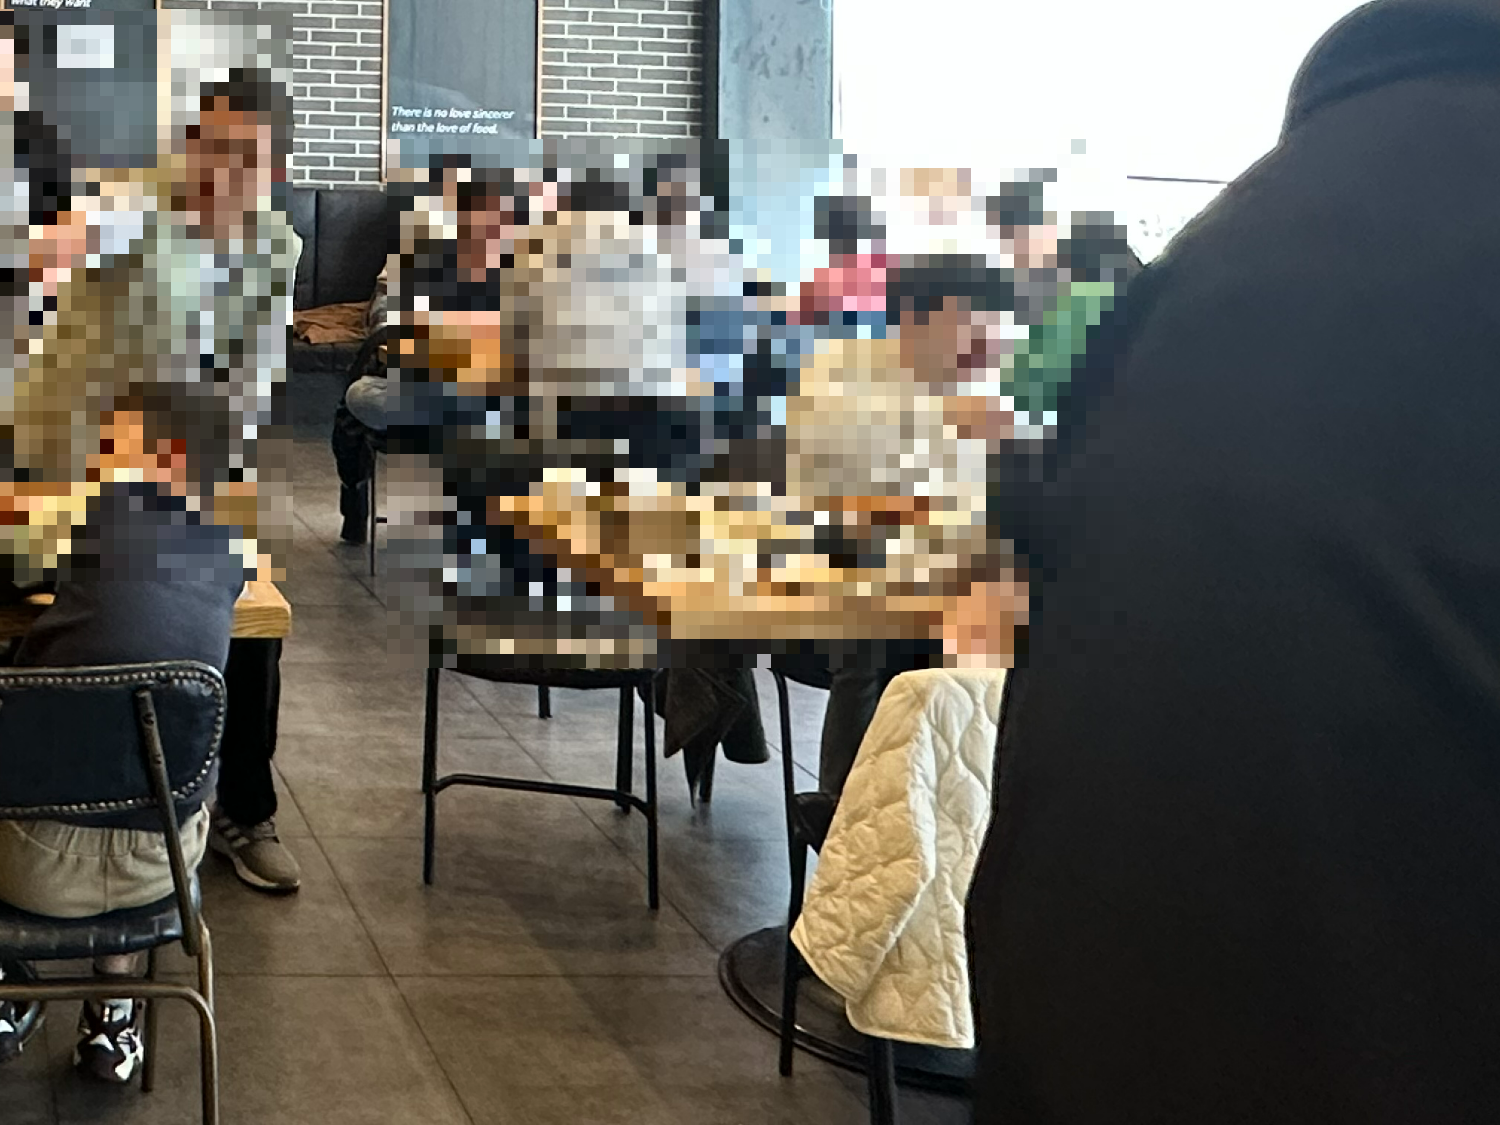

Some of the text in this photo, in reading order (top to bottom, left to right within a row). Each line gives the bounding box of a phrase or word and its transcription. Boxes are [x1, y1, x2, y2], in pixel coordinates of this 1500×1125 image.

[391, 106, 515, 119] There is no love sincerer
[391, 121, 415, 133] than
[417, 122, 435, 133] the
[436, 122, 458, 134] love
[459, 122, 472, 134] of
